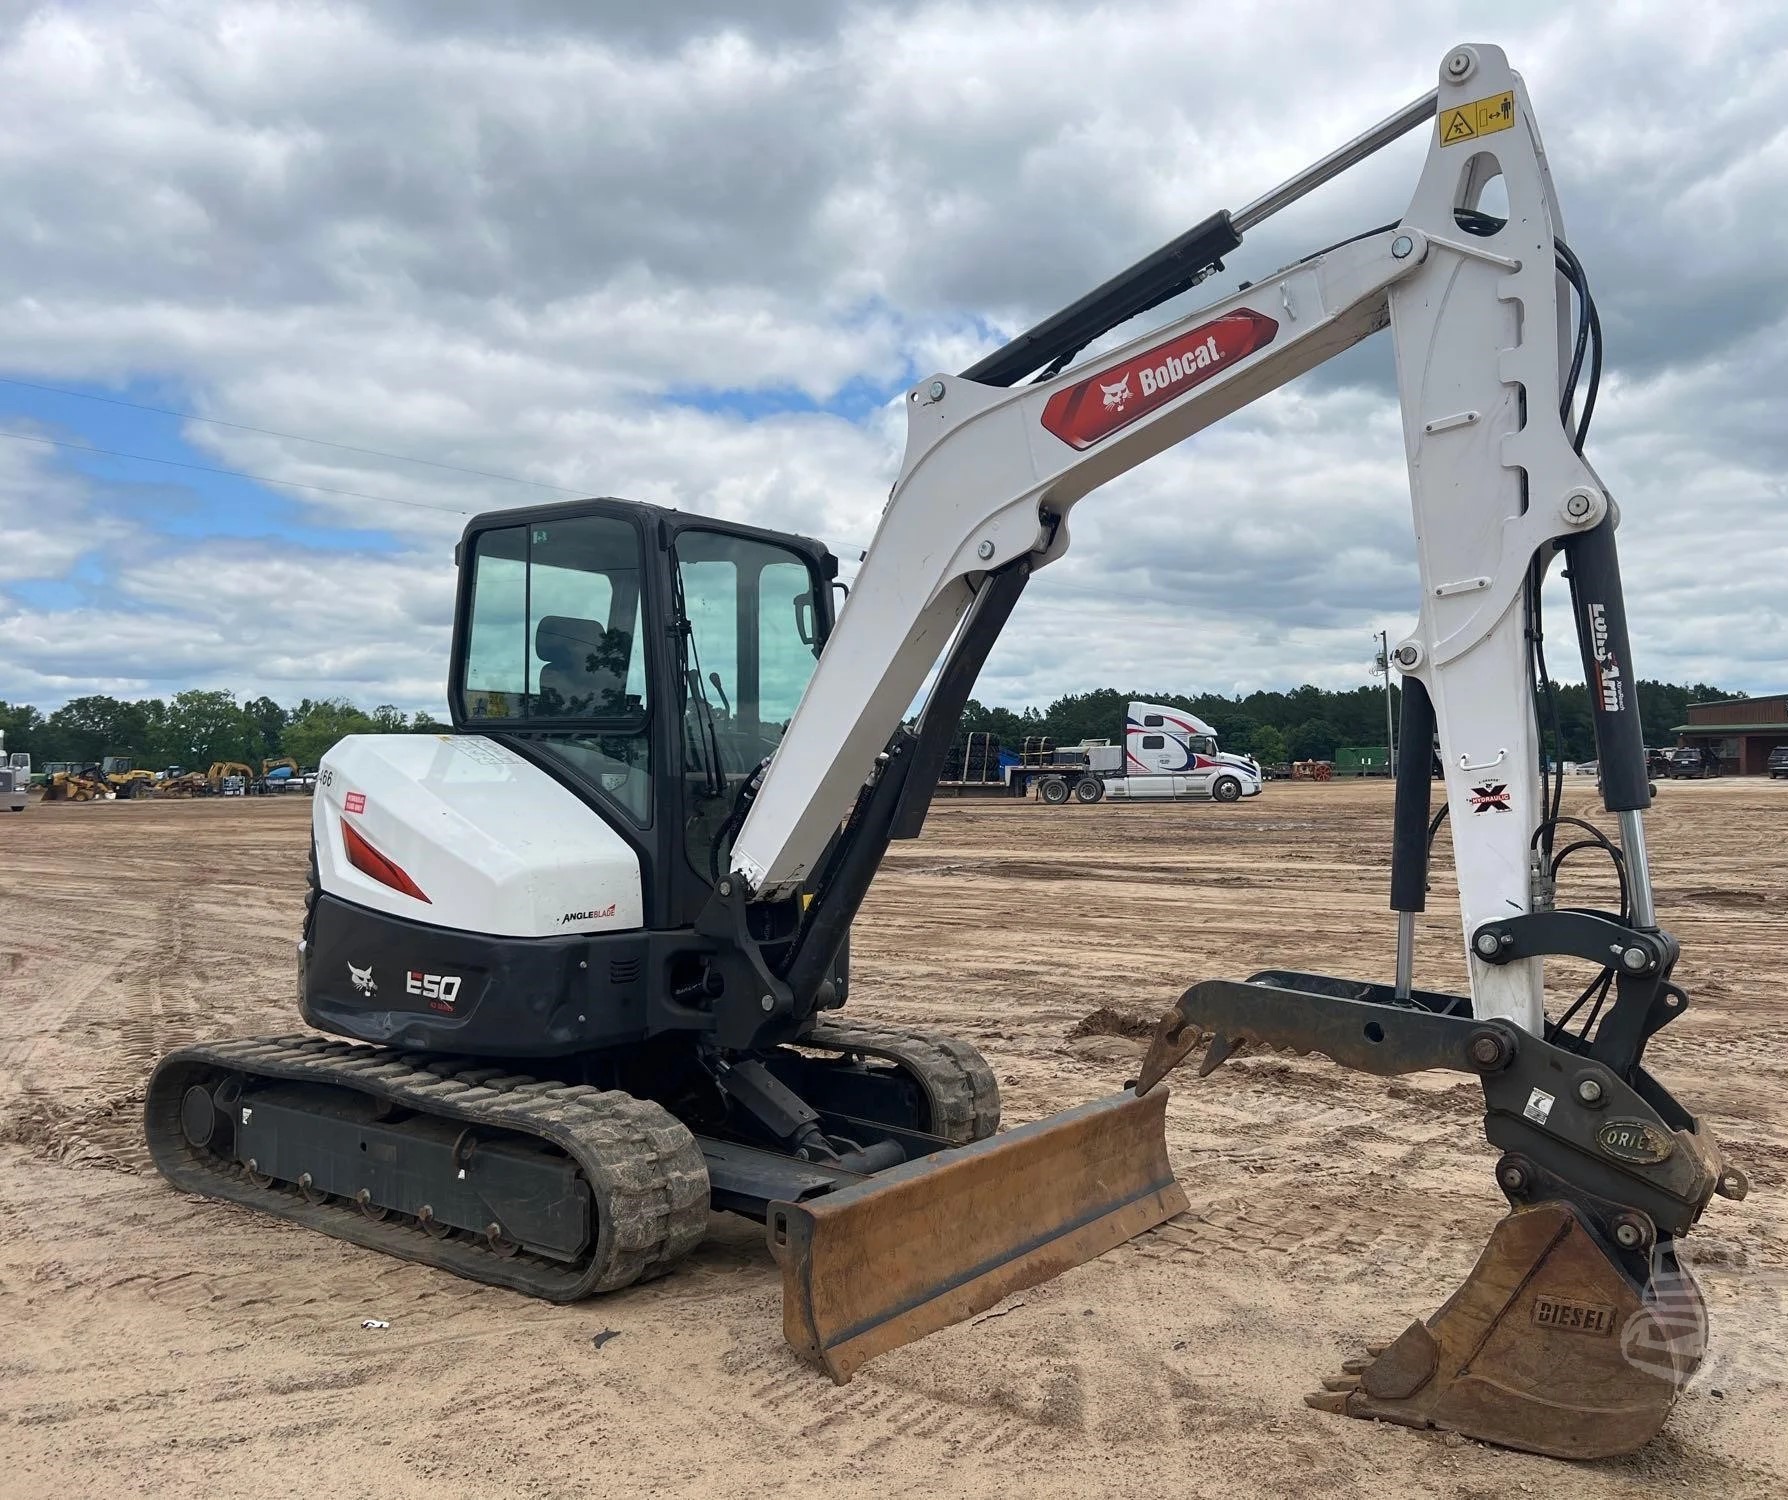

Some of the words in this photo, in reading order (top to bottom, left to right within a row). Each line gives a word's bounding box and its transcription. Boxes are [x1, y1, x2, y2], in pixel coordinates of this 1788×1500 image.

[1138, 335, 1220, 397] Bobcat
[406, 970, 462, 1002] E50
[1538, 1302, 1604, 1331] DIESEL
